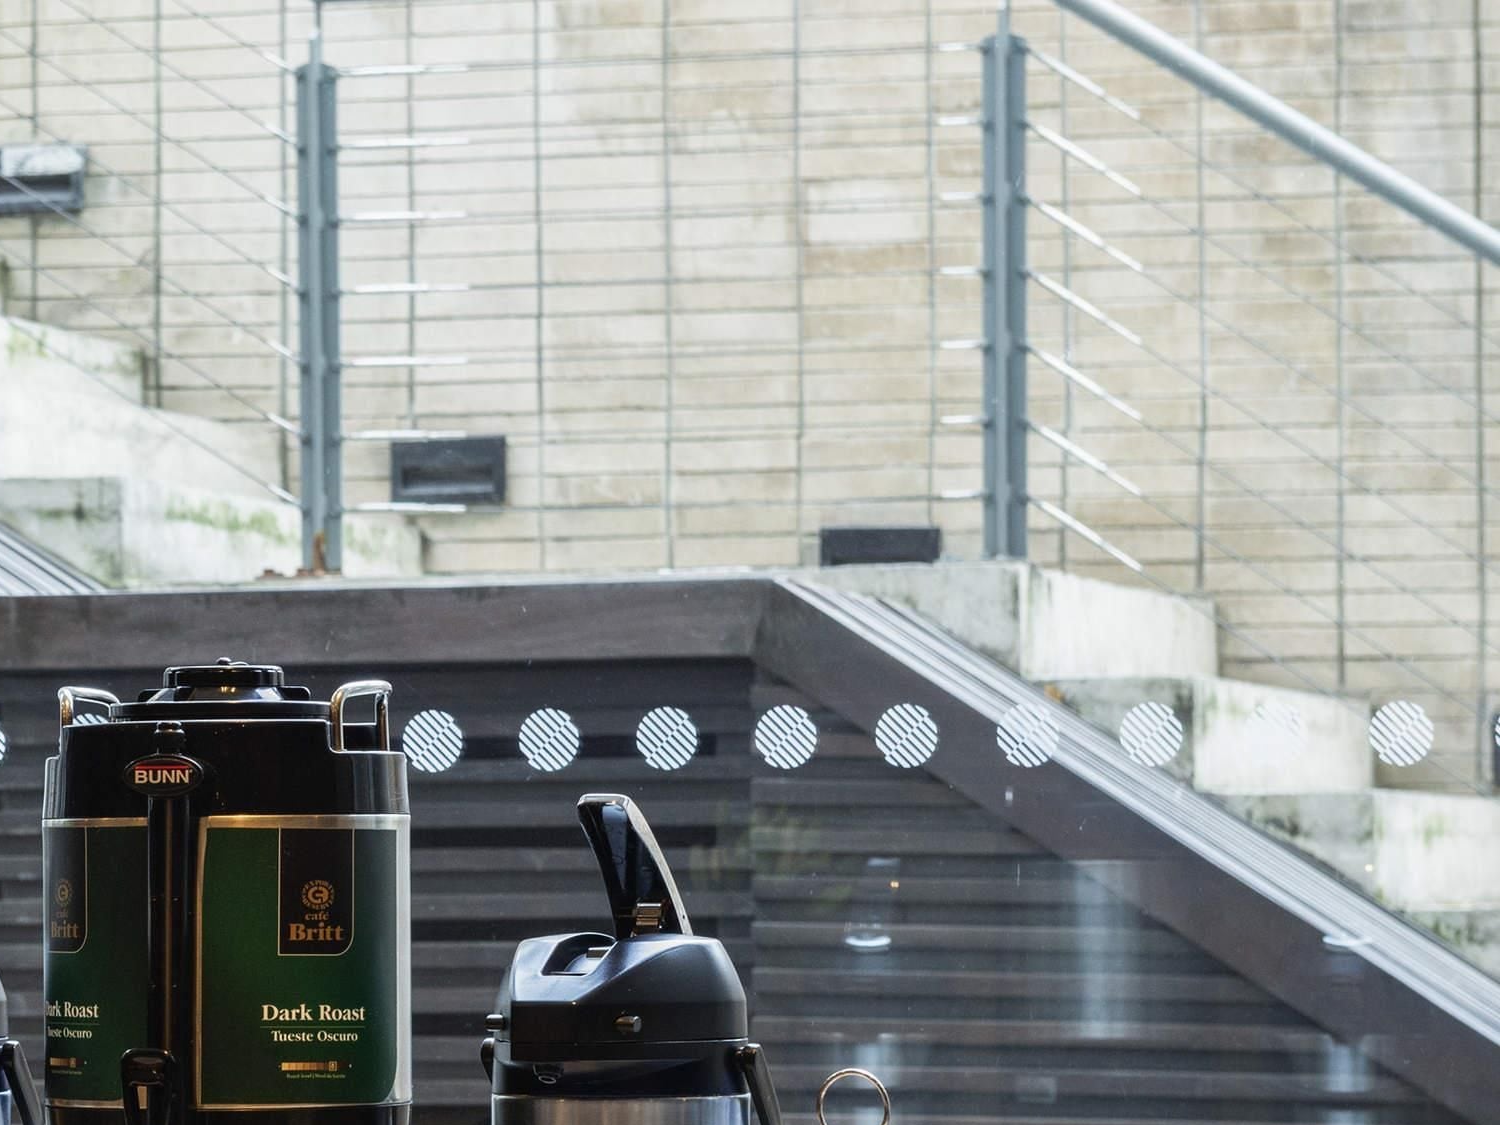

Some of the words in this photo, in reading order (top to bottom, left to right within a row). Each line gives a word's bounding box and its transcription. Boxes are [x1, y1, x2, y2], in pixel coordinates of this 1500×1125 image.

[134, 769, 190, 784] BUNN
[289, 922, 344, 941] Britt
[64, 1001, 100, 1018] Roast
[261, 1004, 313, 1021] Dark
[318, 1004, 365, 1021] Roast
[63, 1027, 93, 1039] Oscuro
[270, 1030, 314, 1042] Tueste
[317, 1030, 358, 1042] Oscuro
